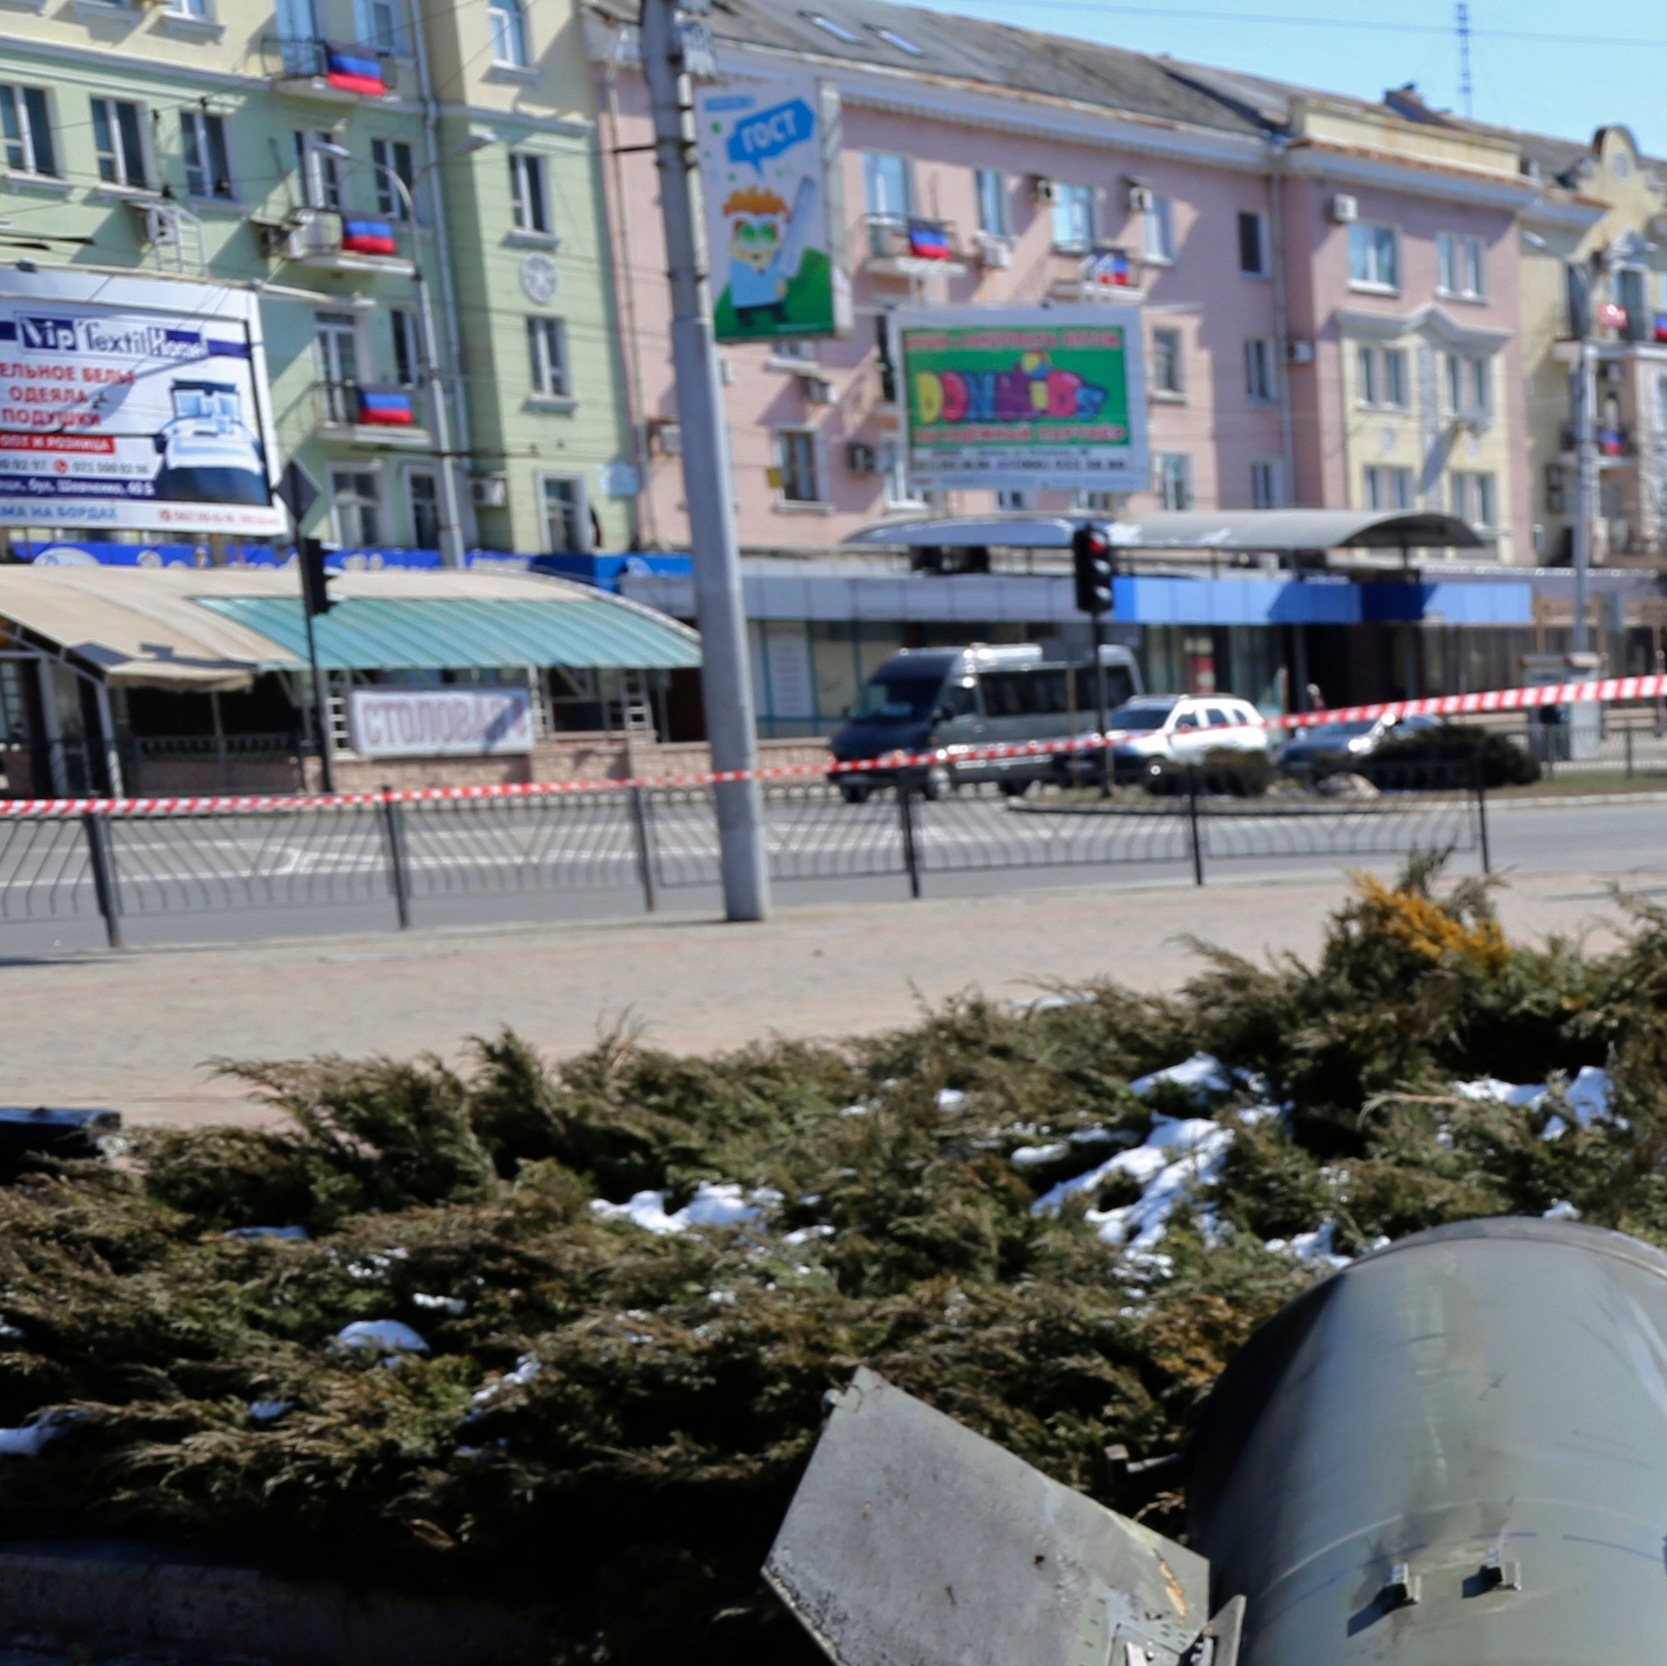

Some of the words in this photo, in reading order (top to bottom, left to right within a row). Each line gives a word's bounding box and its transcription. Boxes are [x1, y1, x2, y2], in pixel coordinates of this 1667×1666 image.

[741, 108, 797, 153] ГОСТ
[9, 386, 88, 403] ОДЕЯЛА
[2, 408, 100, 427] ПОДУШКИ
[46, 436, 111, 451] РОЗНИЦА
